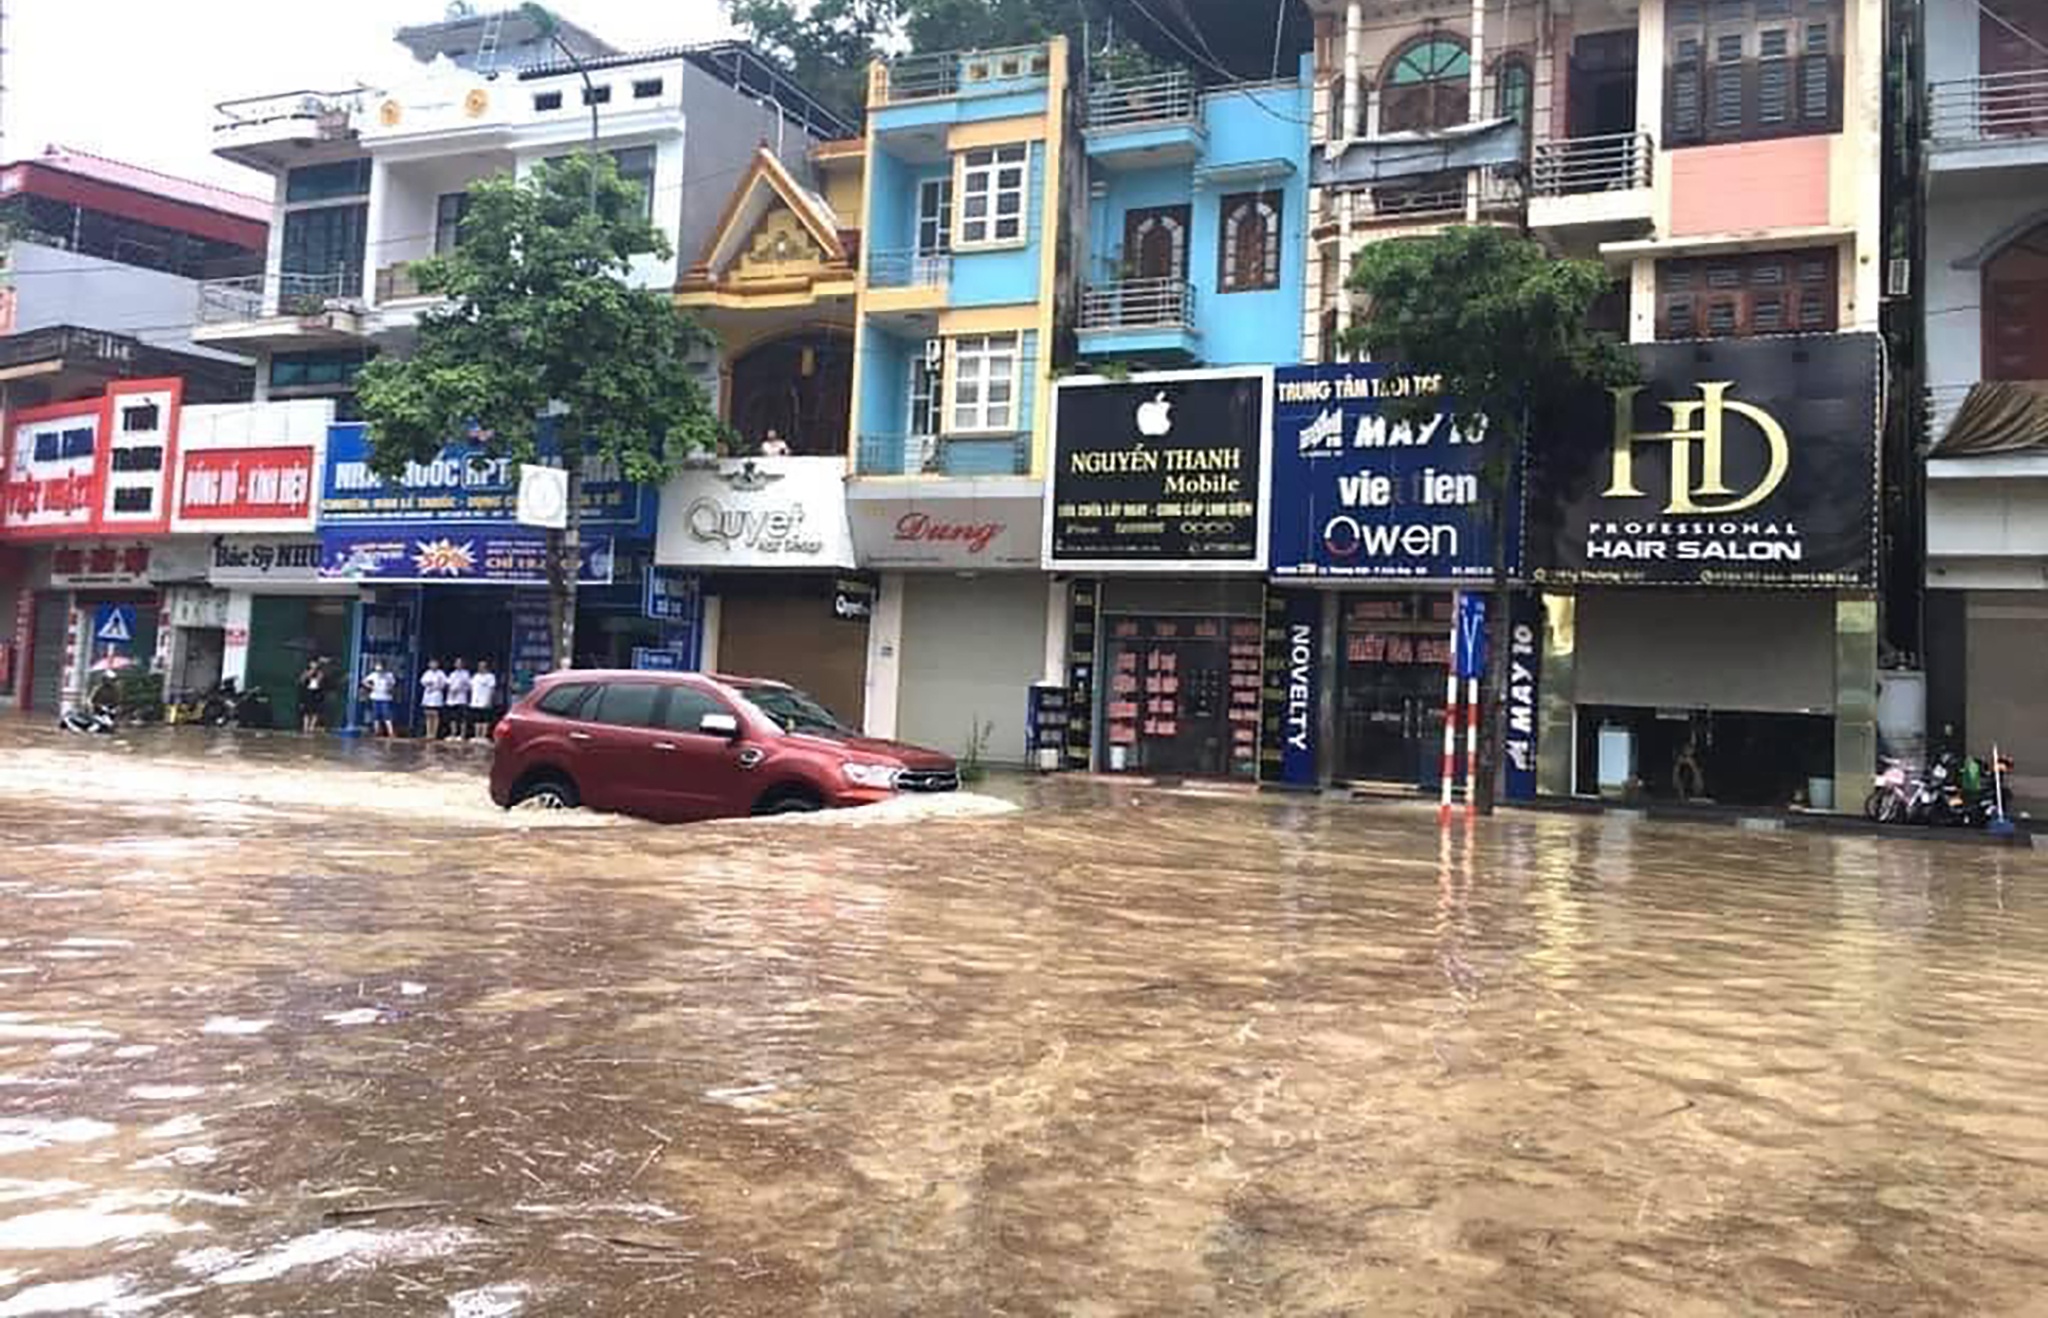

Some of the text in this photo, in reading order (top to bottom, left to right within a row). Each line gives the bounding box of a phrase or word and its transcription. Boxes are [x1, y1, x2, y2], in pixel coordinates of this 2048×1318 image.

[1278, 382, 1332, 402] TRUNG
[1335, 374, 1369, 398] TÂM
[1354, 413, 1443, 448] MAY
[1163, 447, 1241, 470] THANH
[1164, 473, 1242, 495] Mobile
[1324, 515, 1458, 557] Owen
[1589, 522, 1799, 535] PROFESSIONAL
[1587, 540, 1802, 560] HAIR SALON
[1288, 623, 1311, 751] NOVELTY
[1510, 624, 1534, 734] MAY 10
